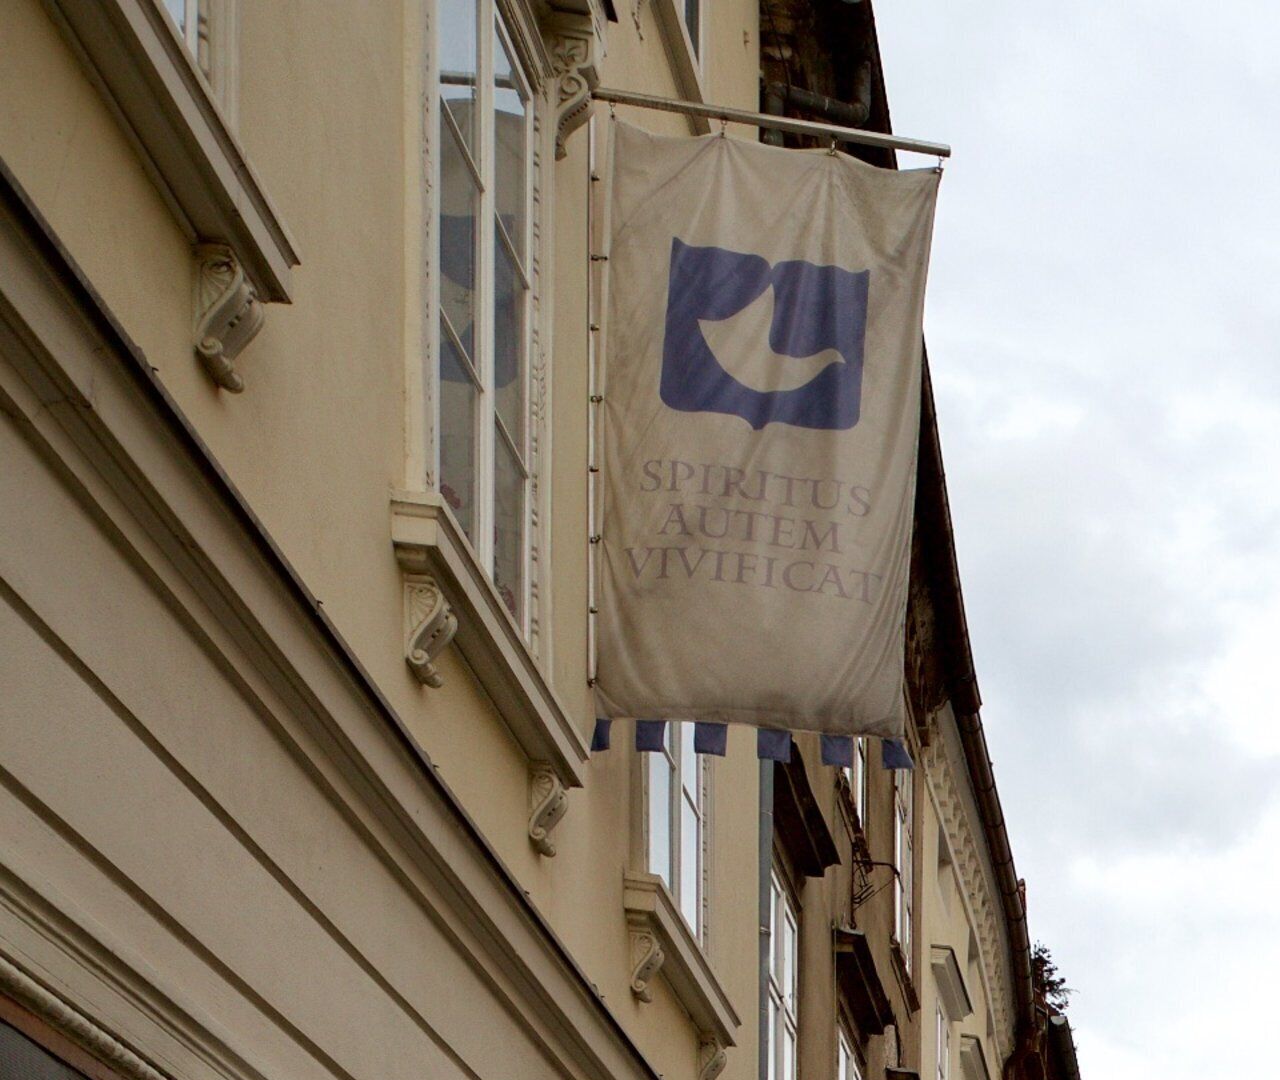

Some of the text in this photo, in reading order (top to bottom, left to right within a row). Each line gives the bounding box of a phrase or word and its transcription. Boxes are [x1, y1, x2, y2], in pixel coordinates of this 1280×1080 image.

[639, 459, 872, 517] SPIRITUS
[657, 503, 843, 554] AUTEM
[622, 547, 883, 605] VIVIFICAT
